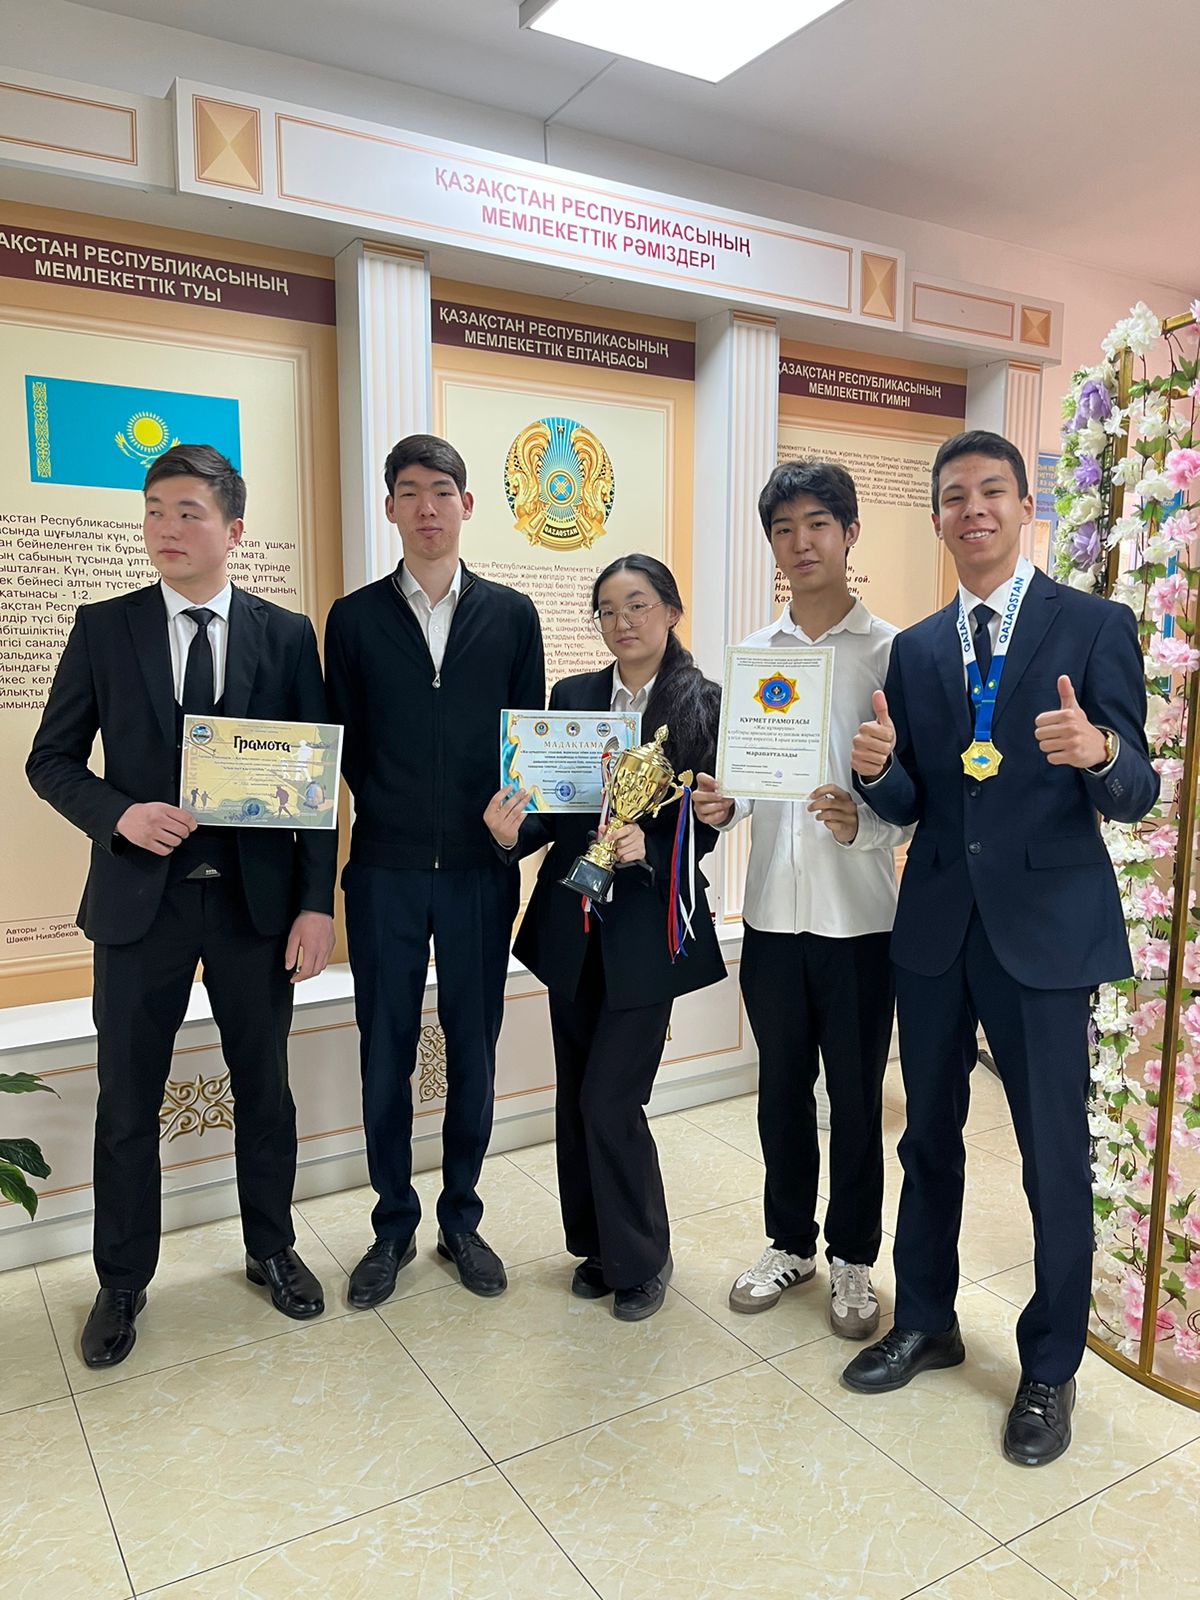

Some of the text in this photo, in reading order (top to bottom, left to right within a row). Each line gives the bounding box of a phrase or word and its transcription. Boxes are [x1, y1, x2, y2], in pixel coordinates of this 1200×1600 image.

[435, 166, 752, 257] ҚАЗАҚСТАН РЕСПУБЛИКАСЫНЫҢ
[481, 204, 716, 271] МЕМЛЕКЕТТІК РӘМІЗДЕРІ
[35, 259, 222, 303] МЕМЛЕКЕТТІК ТУЫ
[84, 244, 289, 296] РЕСПУБЛИКАСЫНЫҢ
[439, 306, 669, 358] ҚАЗАҚСТАН РЕСПУБЛИКАСЫНЫҢ
[464, 329, 649, 370] МЕМЛЕКЕТТІК ЕЛТАҢБАСЫ
[808, 382, 911, 408] МЕМЛЕКЕТТІК ГИМНІ
[838, 371, 942, 399] РЕСПУБЛИКАСЫНЫҢ
[0, 527, 40, 537] сында
[264, 540, 296, 550] ұшқан
[17, 539, 93, 552] бейнеленген
[97, 544, 111, 552] тік
[18, 552, 73, 564] сабының
[254, 563, 291, 573] түрінде
[64, 565, 89, 577] Күн,
[92, 569, 122, 578] оның
[17, 576, 63, 587] бейнесі
[67, 580, 102, 588] алтын
[0, 589, 58, 599] қатынасы
[72, 590, 92, 600] 1:2.
[1, 602, 42, 612] ақстан
[998, 577, 1024, 643] QAZAQSTAN
[31, 614, 53, 624] түсі
[57, 614, 75, 625] бір
[233, 735, 291, 753] Грамота
